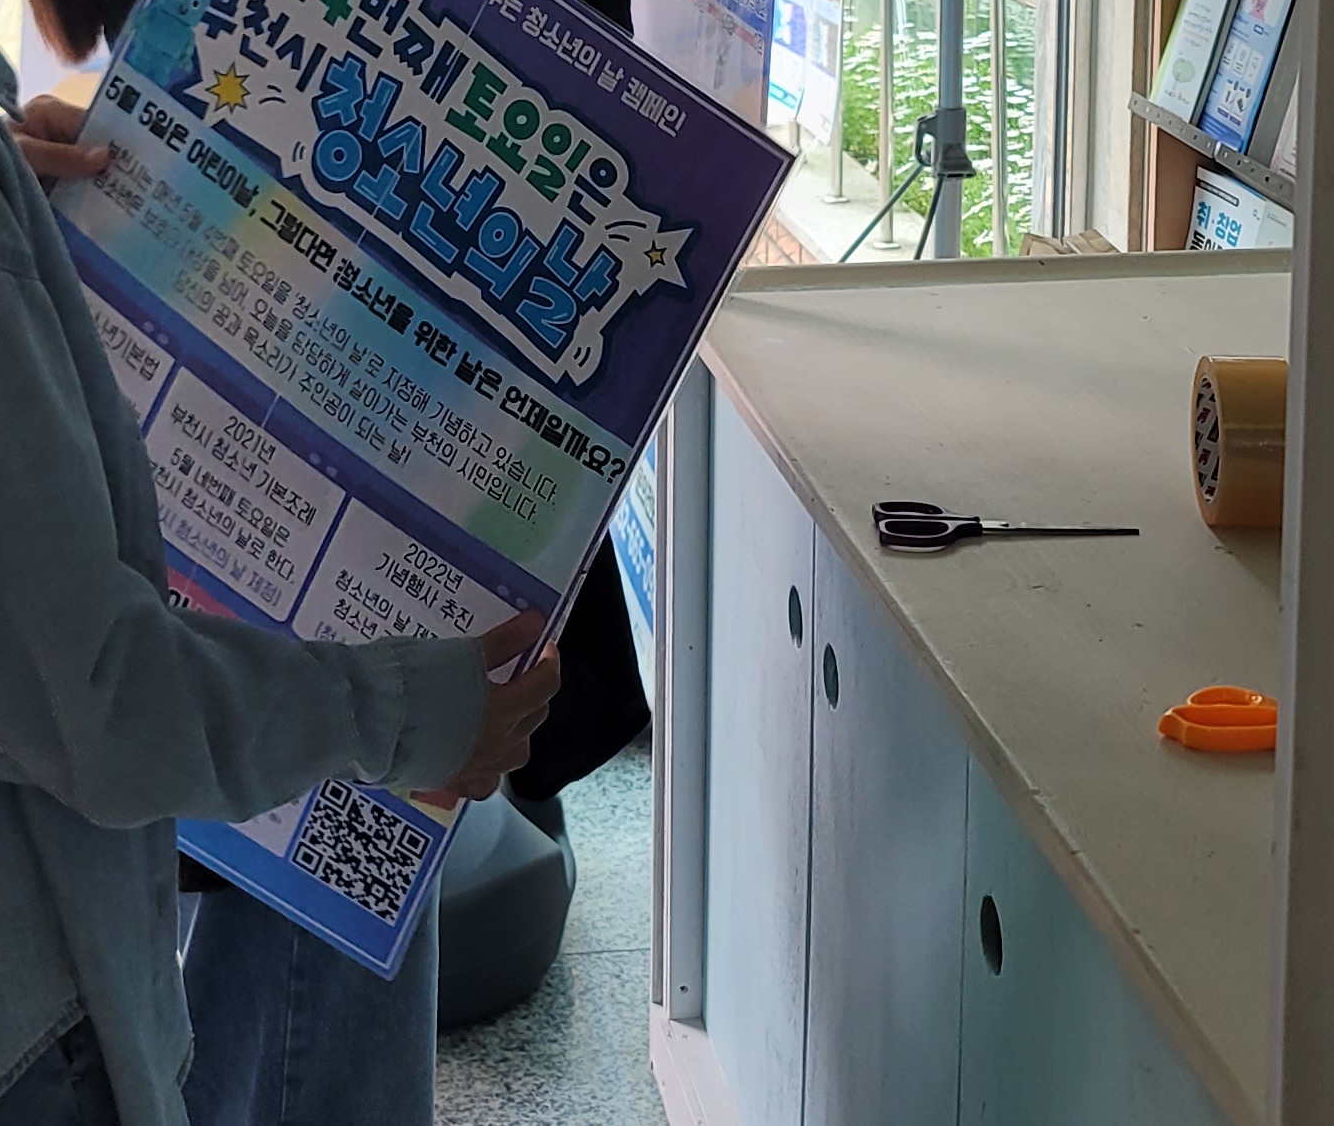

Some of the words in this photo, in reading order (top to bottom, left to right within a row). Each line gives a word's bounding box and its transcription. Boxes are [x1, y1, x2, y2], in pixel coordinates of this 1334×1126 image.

[521, 5, 604, 79] 청소년의
[596, 58, 627, 95] 날
[619, 75, 688, 138] 캠페인
[444, 60, 621, 224] 토요일은
[105, 74, 142, 115] 5월
[138, 100, 189, 154] 5일은
[259, 198, 340, 274] 그렇다면
[413, 319, 459, 368] 위한
[454, 351, 505, 402] 날은
[311, 51, 541, 301] 청소년의
[515, 222, 617, 350] 날
[212, 302, 243, 339] 꿈과
[242, 328, 299, 383] 목소리가
[296, 372, 358, 429] 주인공이
[355, 417, 388, 451] 되는
[237, 249, 294, 305] 토요일을
[381, 365, 431, 415] 지정해
[434, 400, 496, 460] 기념하고
[249, 297, 295, 347] 오늘을
[291, 328, 352, 389] 당당하게
[351, 376, 410, 433] 살아가는
[409, 421, 461, 468] 부천의
[170, 447, 195, 478] 5월
[171, 403, 210, 450] 부천시
[211, 436, 257, 480] 청소년
[256, 471, 318, 527] 기본조례
[223, 415, 276, 466] 2021년
[180, 486, 237, 539] 청소년의
[236, 522, 269, 561] 날로
[229, 559, 248, 581] 날
[403, 542, 466, 595] 2022년
[332, 599, 380, 641] 청소년
[333, 568, 396, 622] 청소년의
[392, 609, 413, 632] 날
[373, 552, 439, 611] 기념행사
[439, 598, 476, 635] 추진
